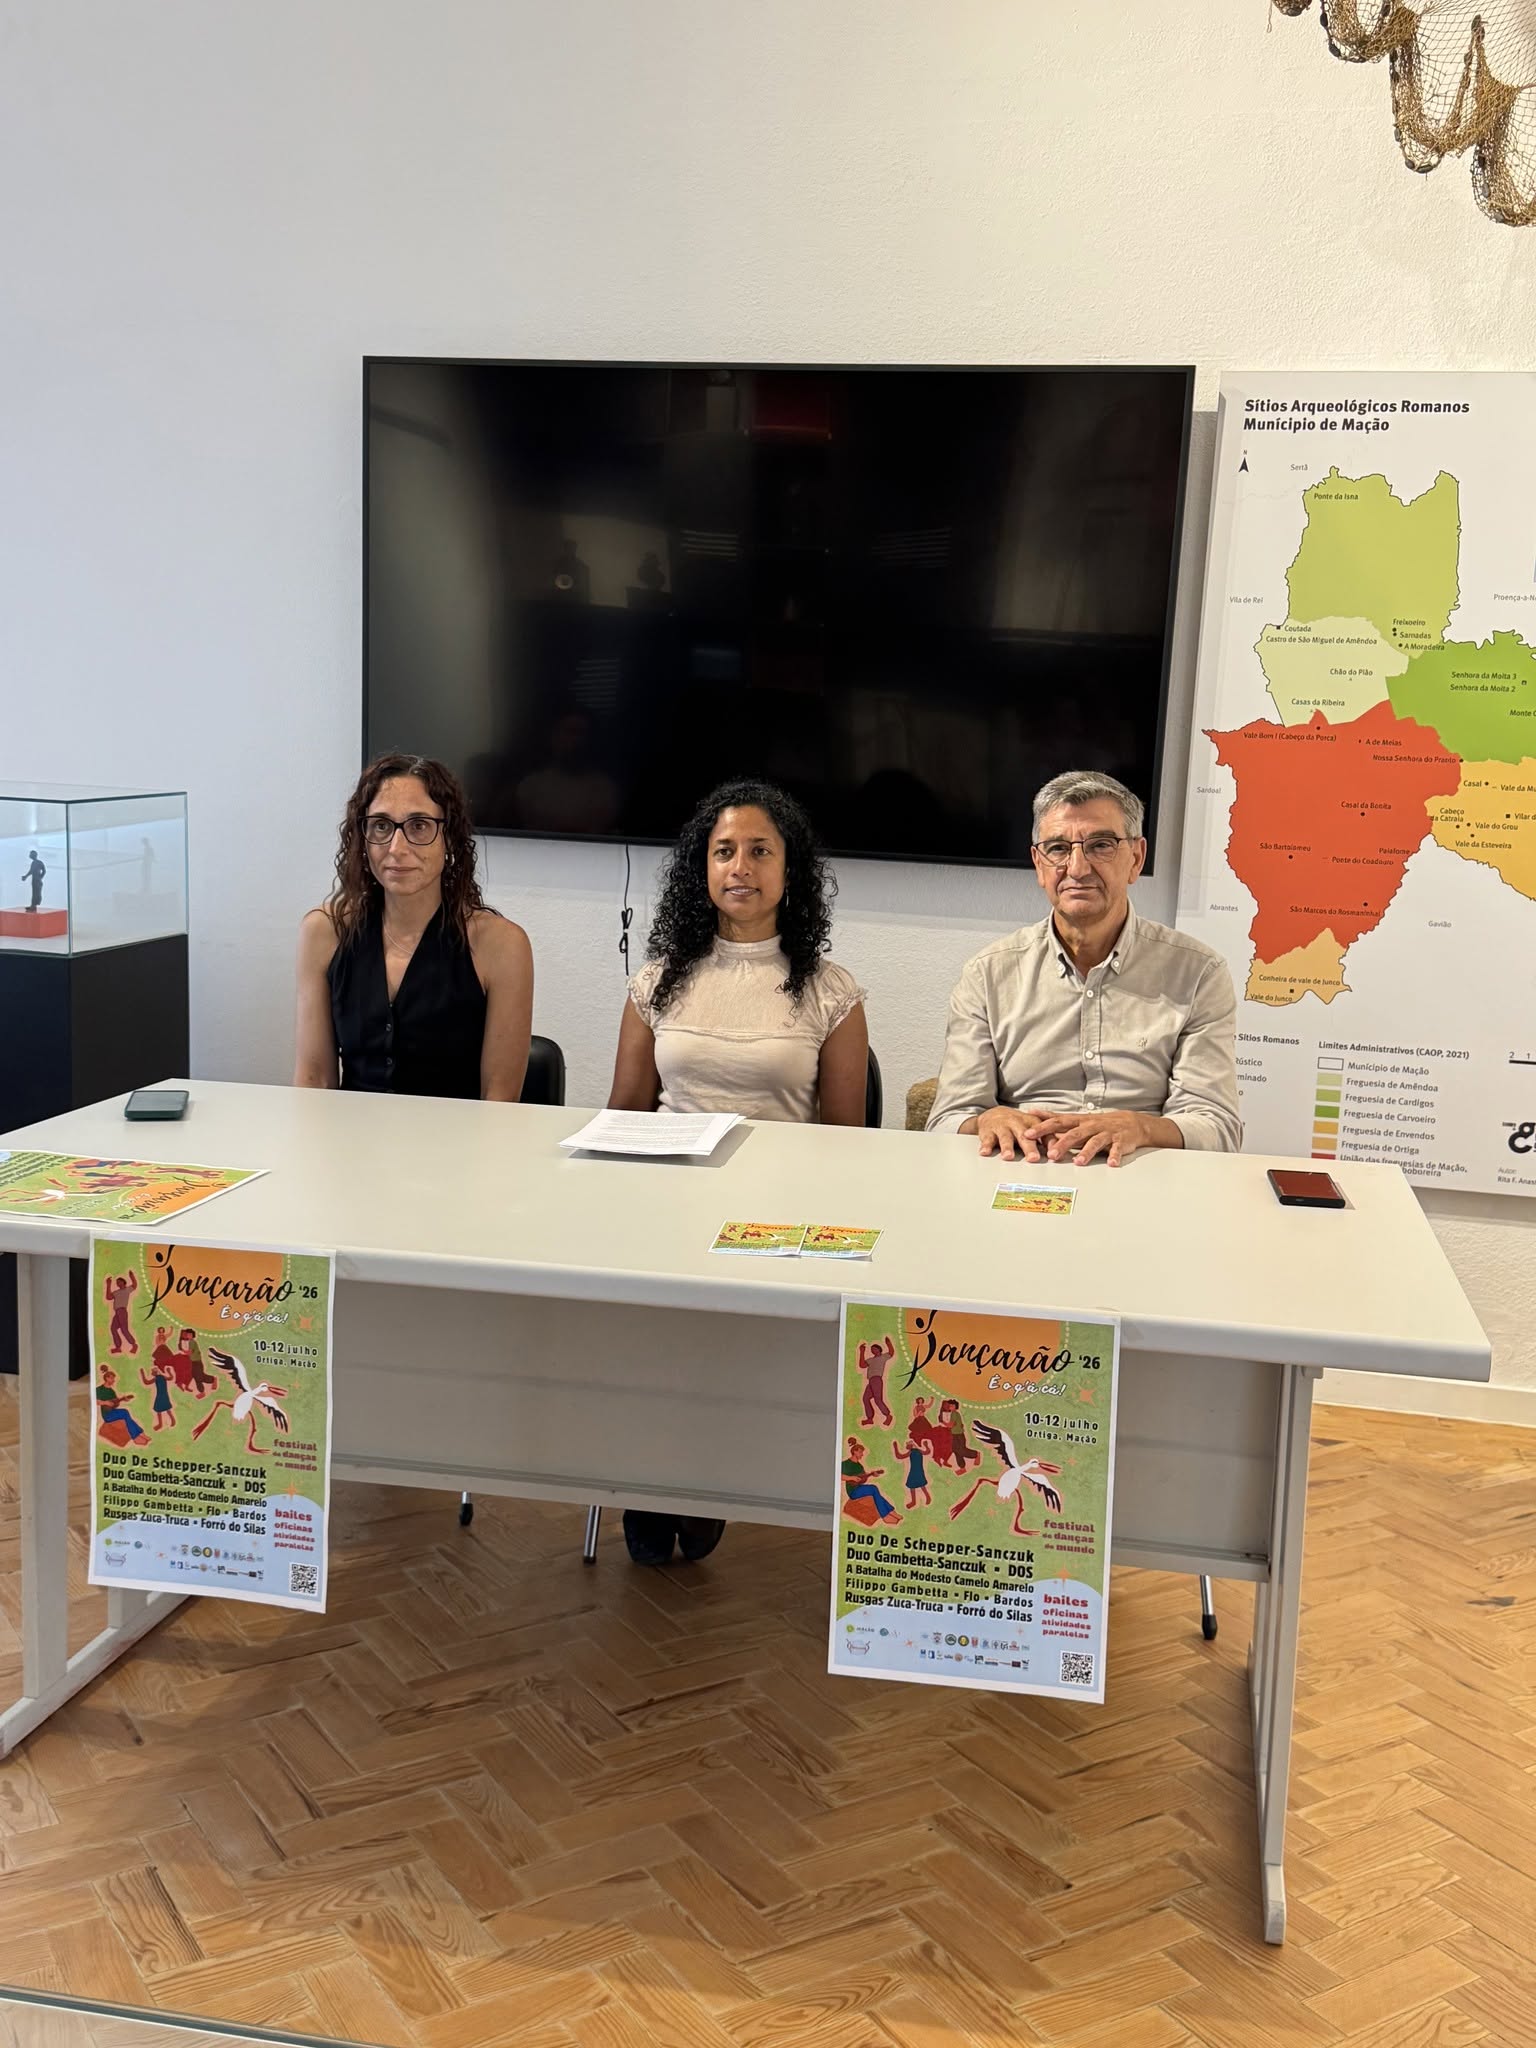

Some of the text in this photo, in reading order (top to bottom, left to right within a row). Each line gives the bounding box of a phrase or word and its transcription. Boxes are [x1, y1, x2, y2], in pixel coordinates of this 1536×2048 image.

[1244, 399, 1470, 415] Sítios Arqueológicos Romanos
[1244, 417, 1390, 434] Munícipio de Mação
[1314, 492, 1334, 500] Ponte
[1229, 596, 1242, 604] Vila
[1243, 596, 1252, 604] de
[1284, 624, 1312, 632] Coutada
[1392, 618, 1426, 626] Freixoeiro
[1298, 636, 1311, 644] São
[1312, 636, 1334, 645] Miguel
[1336, 636, 1344, 644] de
[1346, 636, 1378, 645] Amêndoa
[1330, 668, 1347, 676] Chão
[1348, 668, 1358, 676] do
[1451, 671, 1480, 679] Senhora
[1480, 672, 1490, 680] da
[1450, 684, 1478, 692] Senhora
[1480, 684, 1488, 692] da
[1291, 698, 1310, 706] Casas
[1312, 698, 1320, 706] da
[1463, 780, 1482, 788] Casal
[1491, 822, 1500, 830] do
[1455, 840, 1470, 848] Vale
[1481, 842, 1512, 850] Esteveira
[1210, 904, 1238, 912] Abrantes
[1258, 974, 1340, 986] Conheira de vale de Junco
[1262, 1035, 1300, 1046] Romanos
[1318, 1041, 1470, 1060] Limites Administrativos (CAOP, 2021)
[1390, 1064, 1400, 1073] de
[1402, 1066, 1430, 1076] Mação
[1346, 1078, 1439, 1092] Freguesia de Amêndoa
[1345, 1094, 1434, 1108] Freguesia de Cardigos
[1344, 1109, 1436, 1124] Freguesia de Carvoeiro
[1342, 1125, 1435, 1140] Freguesia de Envendos
[1341, 1140, 1420, 1155] Freguesia de Ortiga
[254, 1340, 318, 1356] 10-12 julho
[290, 1358, 317, 1368] Mação
[1025, 1413, 1098, 1430] 10-12 julho
[1066, 1433, 1097, 1444] Mação
[274, 1438, 318, 1452] festival
[282, 1451, 317, 1462] danças
[103, 1452, 267, 1479] Duo De Schepper-Sanczuk
[284, 1462, 318, 1472] mundo
[103, 1467, 266, 1494] Duo Gambetta-Sanczuk DOS
[103, 1482, 267, 1508] A Batalha do Modesto Camelo Amarelo
[103, 1495, 266, 1522] Filippo Gambetta Flo Bardos
[275, 1508, 312, 1522] bailes
[103, 1508, 266, 1535] Rusgas Zuca-Truca Forró do Silas
[274, 1522, 312, 1533] oficinas
[1044, 1519, 1095, 1533] festival
[273, 1532, 316, 1543] atividades
[1054, 1532, 1094, 1544] danças
[848, 1531, 1034, 1563] Duo De Schepper-Sanczuk
[1056, 1544, 1095, 1555] mundo
[846, 1548, 1033, 1580] Duo Gambetta-Sanczuk DOS
[846, 1564, 1034, 1594] A Batalha do Modesto Camelo Amarelo
[846, 1578, 1034, 1608] Filippo Gambetta Flo Bardos
[1044, 1594, 1088, 1608] bailes
[845, 1592, 1033, 1623] Rusgas Zuca-Truca Forró do Silas
[1042, 1608, 1088, 1620] oficinas
[1042, 1619, 1091, 1630] atividades
[1042, 1628, 1089, 1640] paralelas
